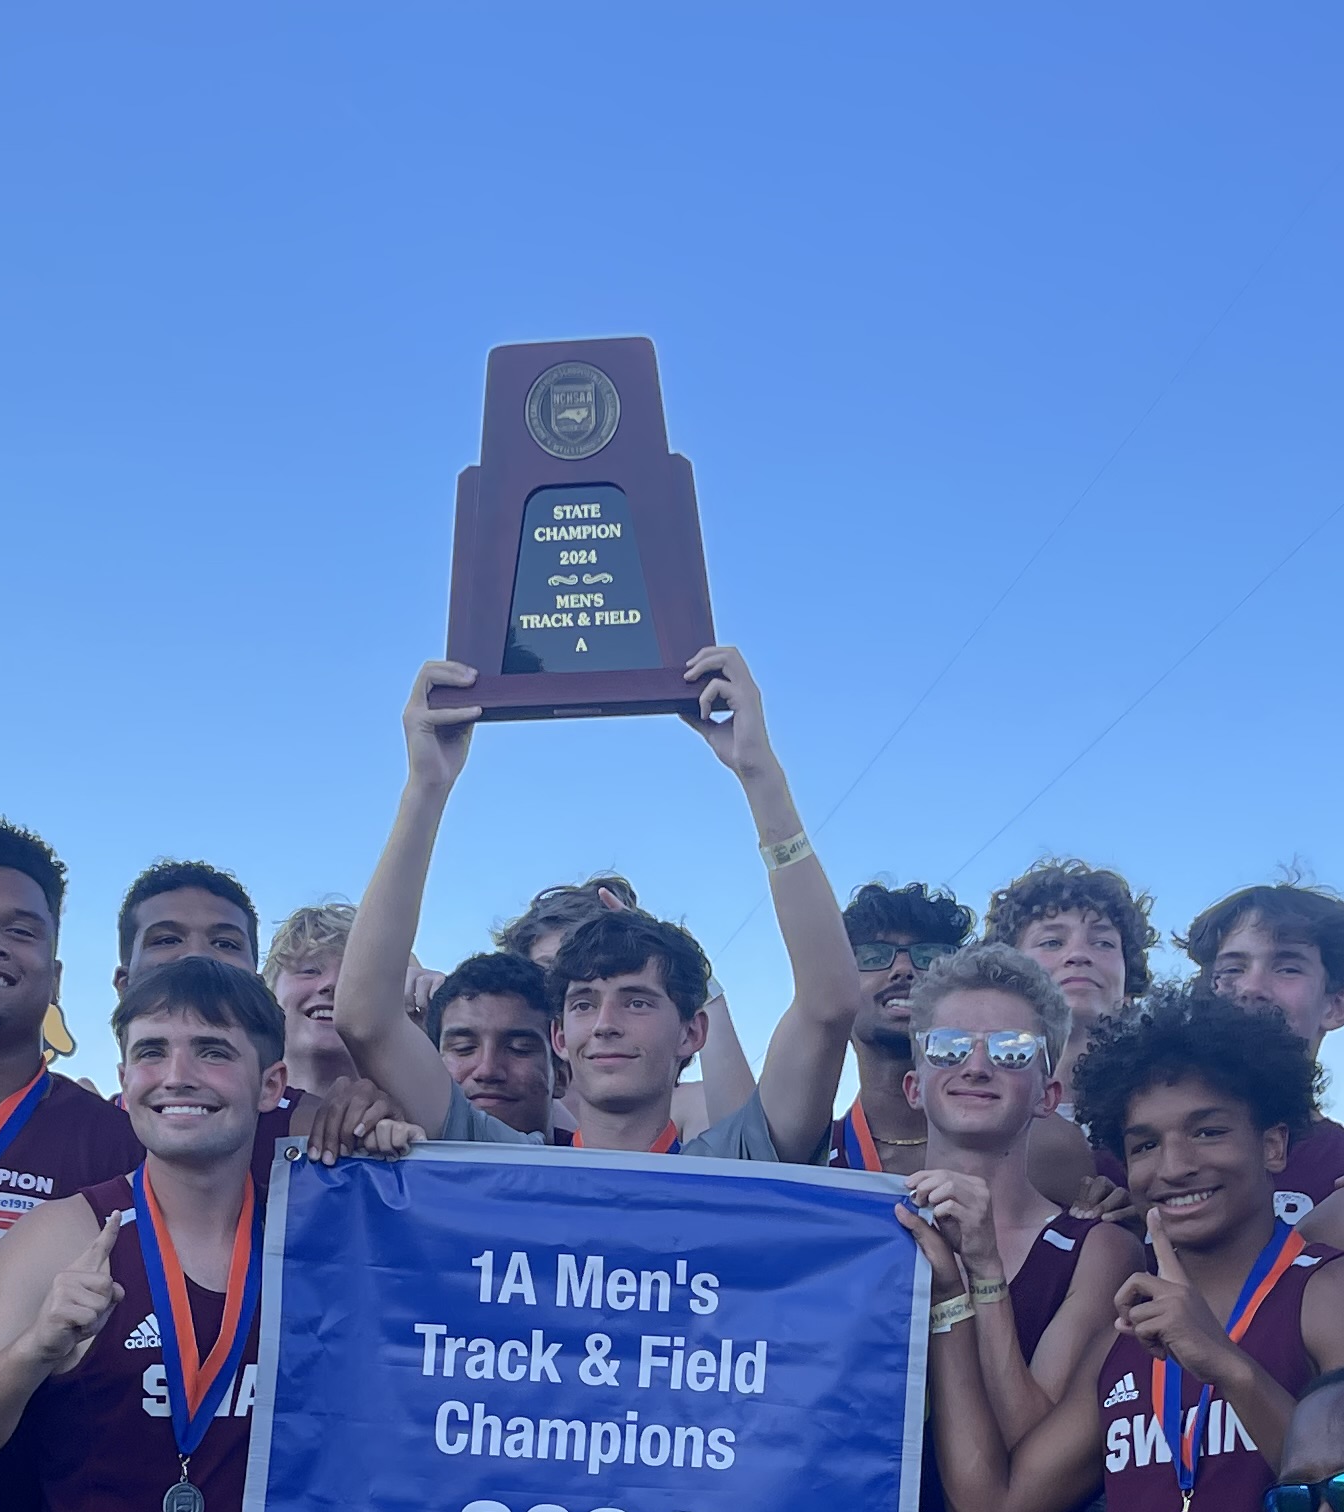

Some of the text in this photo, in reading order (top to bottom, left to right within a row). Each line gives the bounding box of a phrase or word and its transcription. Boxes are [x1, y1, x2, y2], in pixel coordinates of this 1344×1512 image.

[553, 503, 601, 520] STATE
[534, 523, 621, 541] CHAMPION
[560, 550, 597, 565] 2024
[556, 593, 604, 609] MEN'S
[520, 610, 641, 629] TRACK & FIELD
[576, 638, 587, 652] A
[471, 1250, 720, 1315] 1A Men's
[124, 1335, 162, 1349] adid
[414, 1322, 768, 1395] Track & Field
[434, 1400, 737, 1475] Champions
